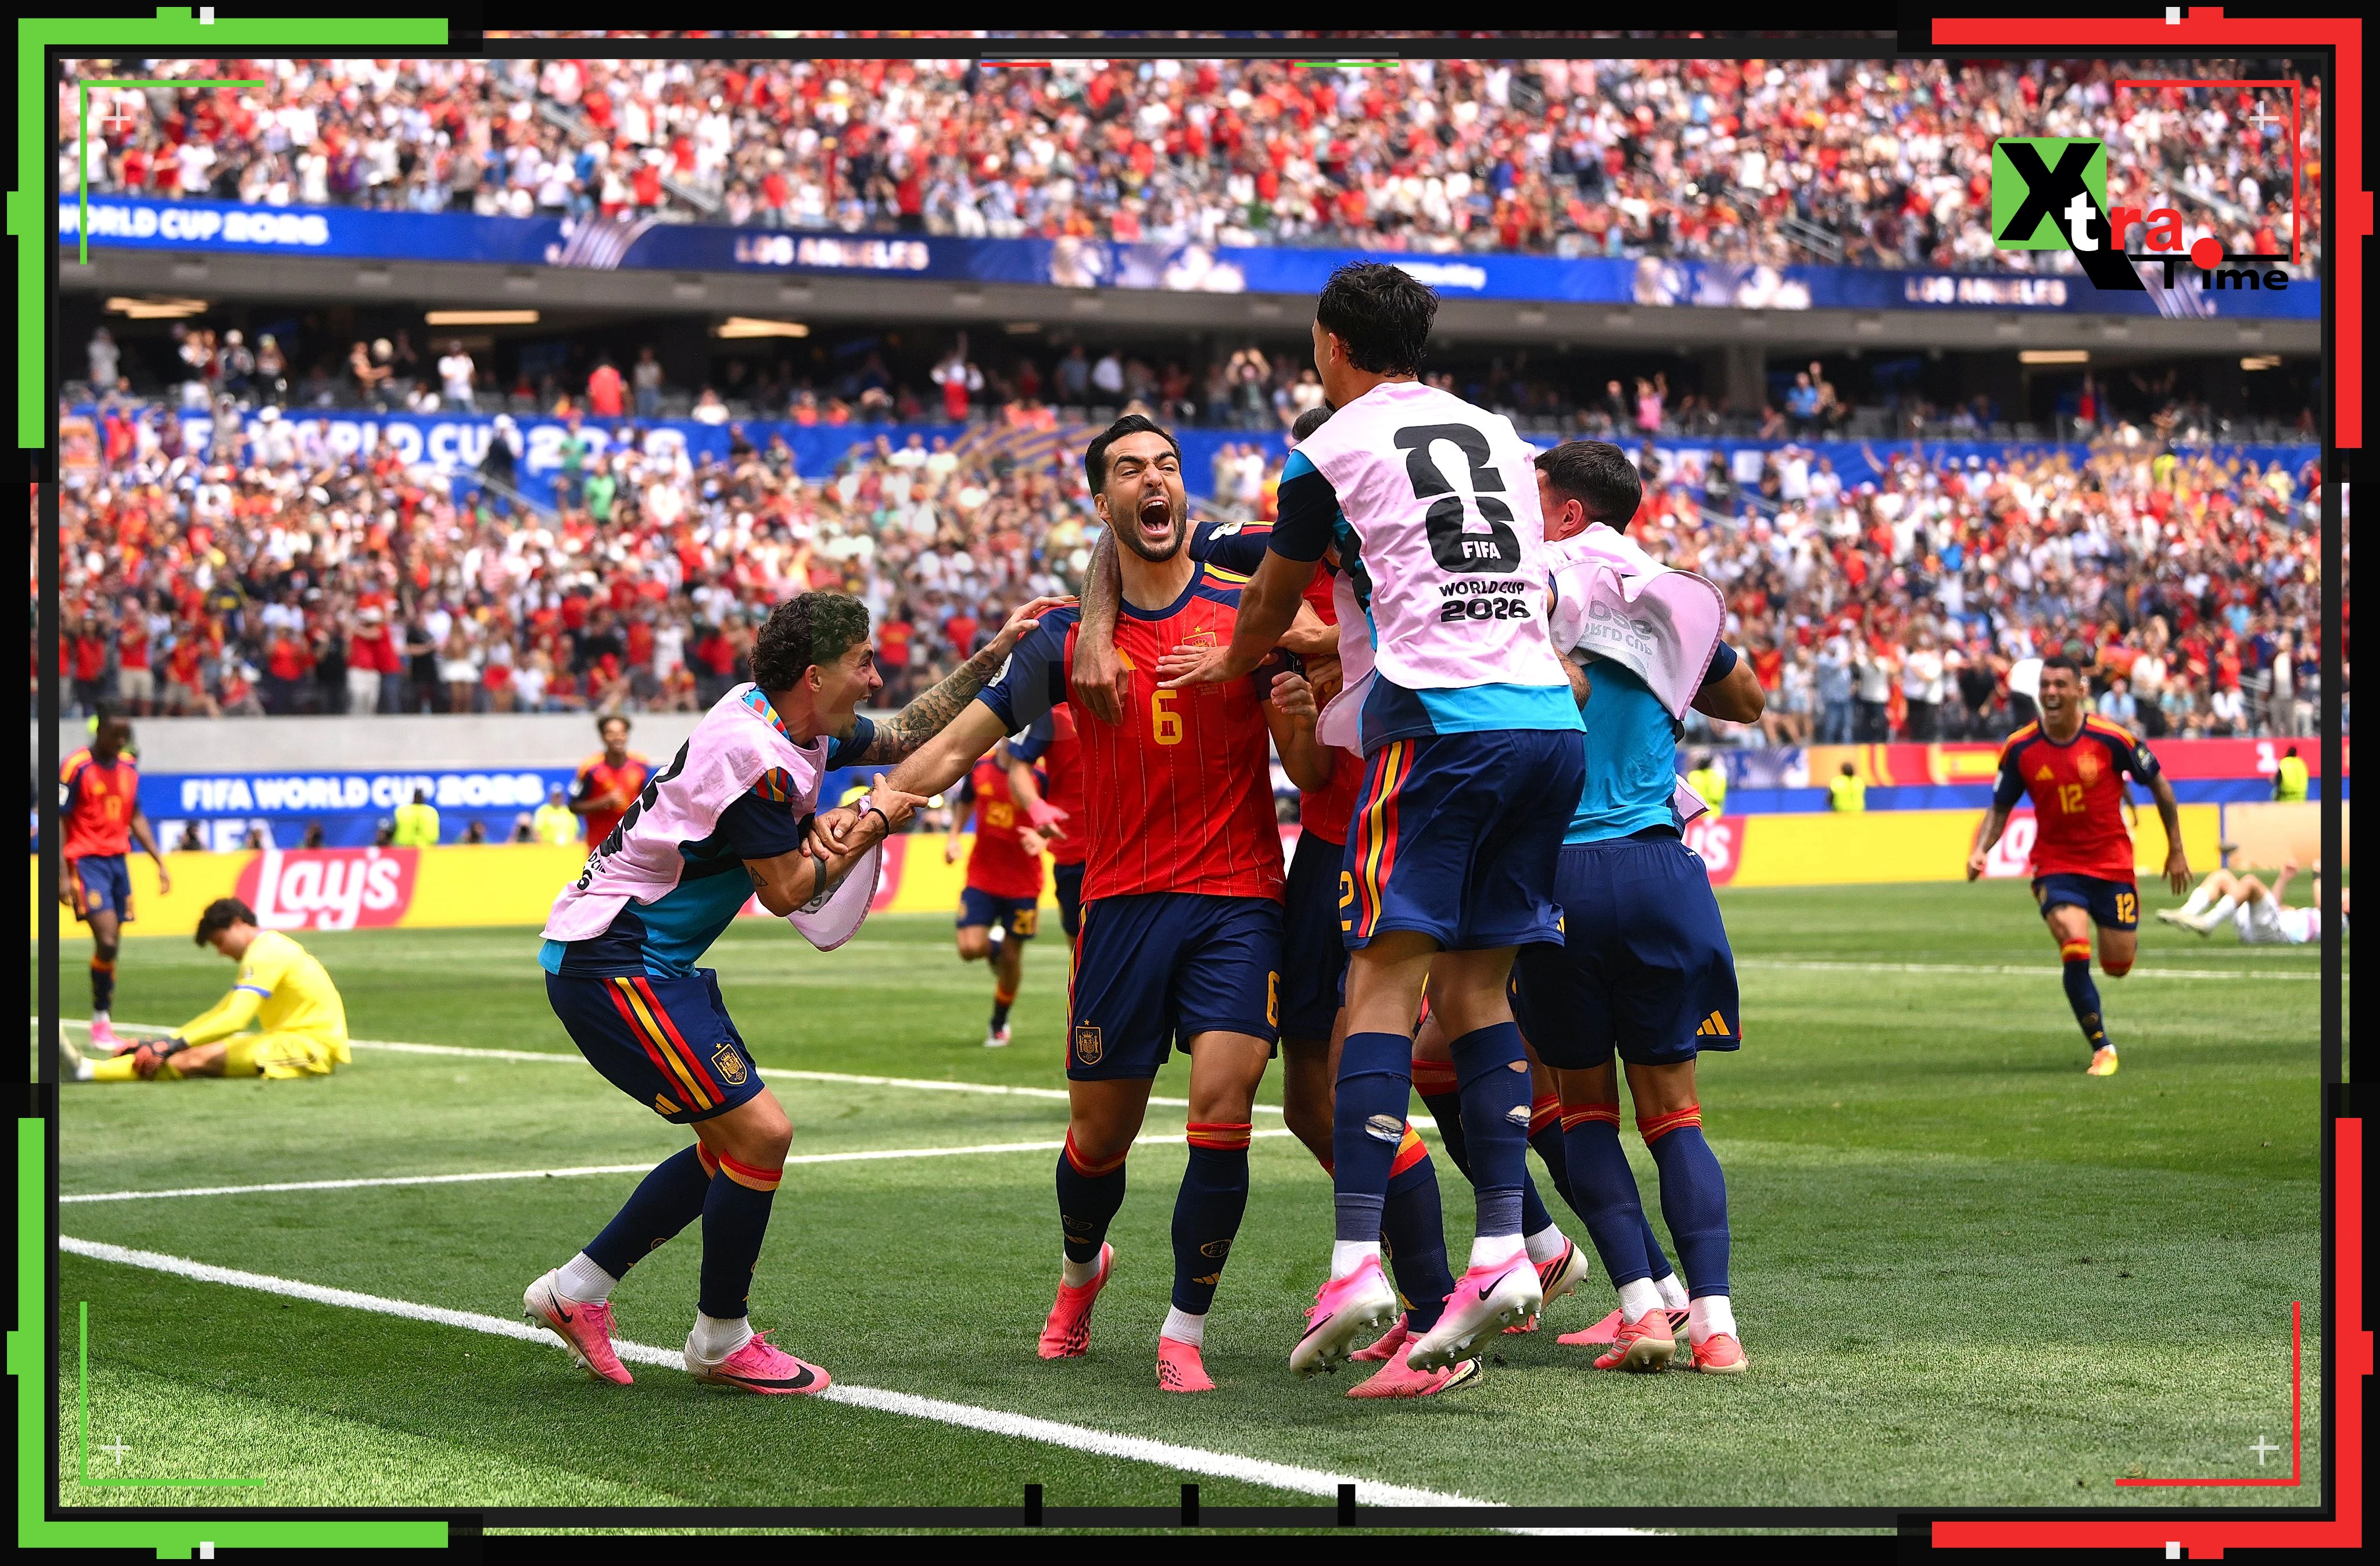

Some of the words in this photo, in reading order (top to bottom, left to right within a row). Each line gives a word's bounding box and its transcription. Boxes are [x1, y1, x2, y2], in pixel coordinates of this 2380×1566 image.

[159, 209, 223, 241] CUP
[223, 211, 329, 246] 2026
[1461, 540, 1502, 560] FIFA
[1439, 581, 1498, 597] WORLD
[1499, 581, 1525, 595] CUP
[1440, 597, 1531, 622] 2026
[1151, 689, 1183, 745] 6
[182, 778, 253, 811] FIFA
[253, 776, 370, 808] WORLD
[370, 775, 435, 807] CUP
[435, 774, 544, 806] 2026
[2058, 784, 2086, 815] 12
[256, 847, 401, 931] Lay's
[2116, 893, 2136, 923] 12
